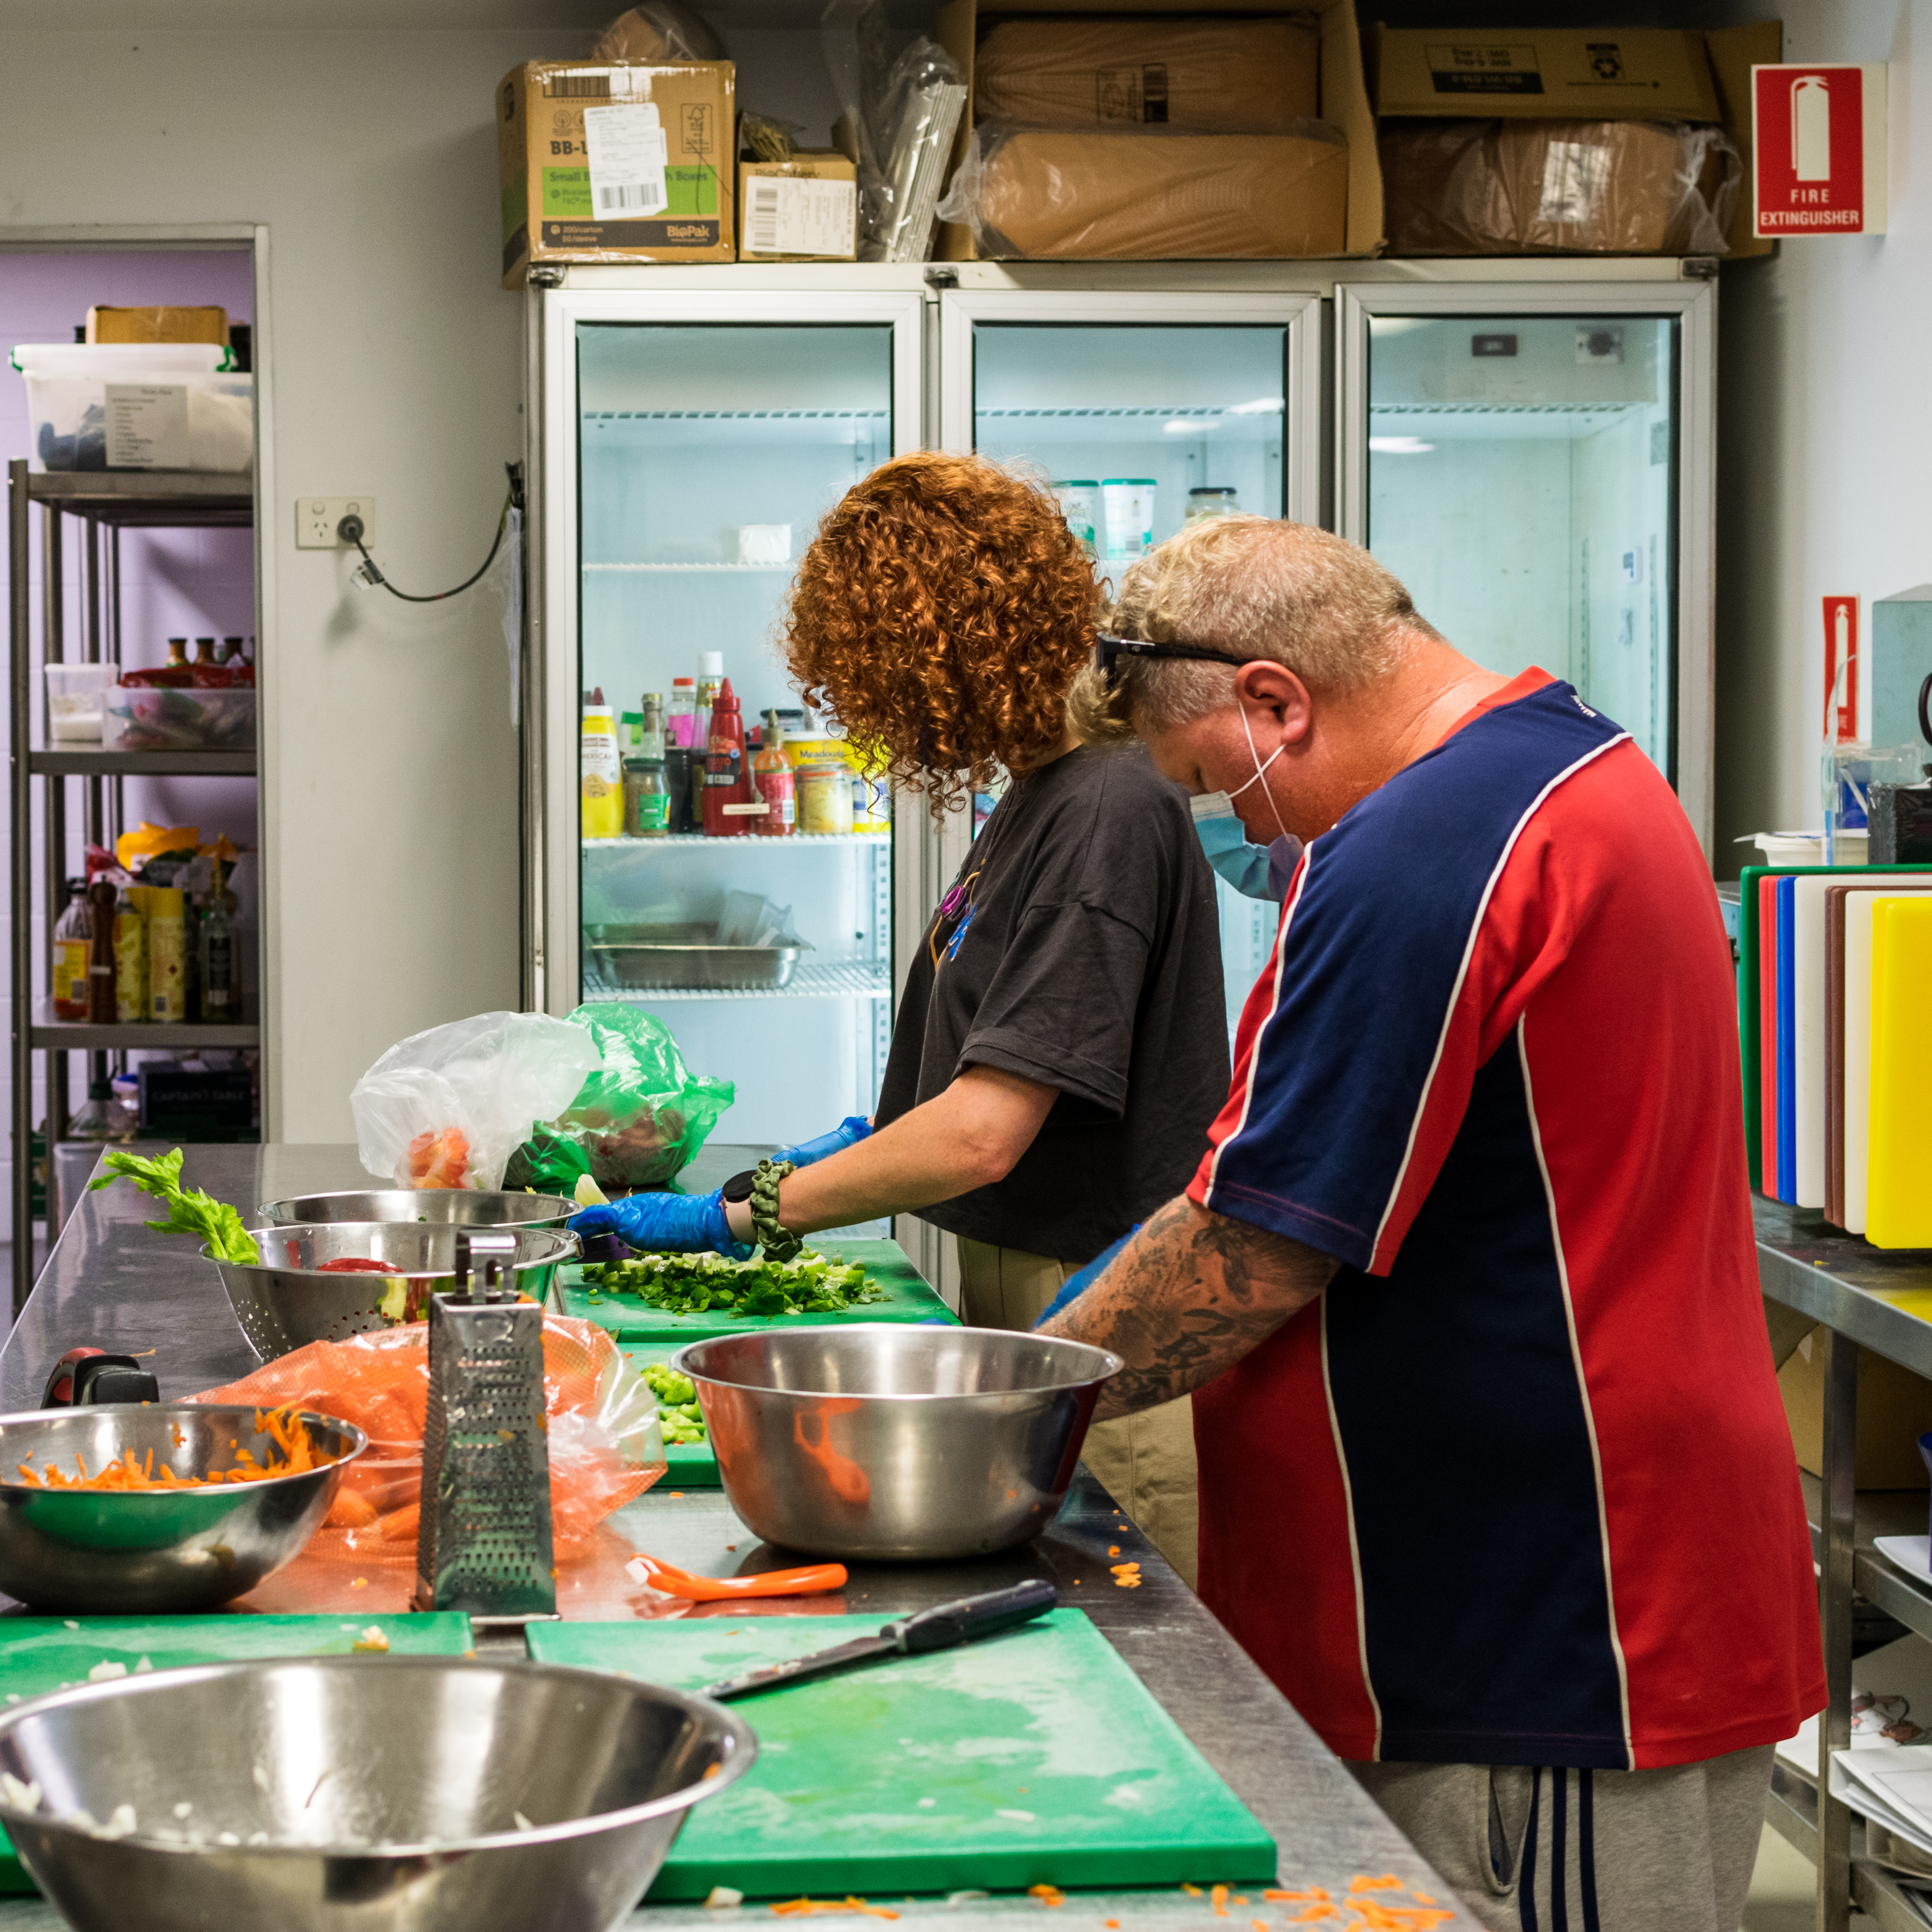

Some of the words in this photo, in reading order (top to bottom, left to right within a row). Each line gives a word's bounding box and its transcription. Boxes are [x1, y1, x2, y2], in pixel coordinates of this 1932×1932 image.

[550, 172, 581, 182] Small
[1790, 189, 1830, 204] FIRE
[1760, 210, 1860, 226] EXTINGUISHER
[667, 225, 710, 237] BioPak
